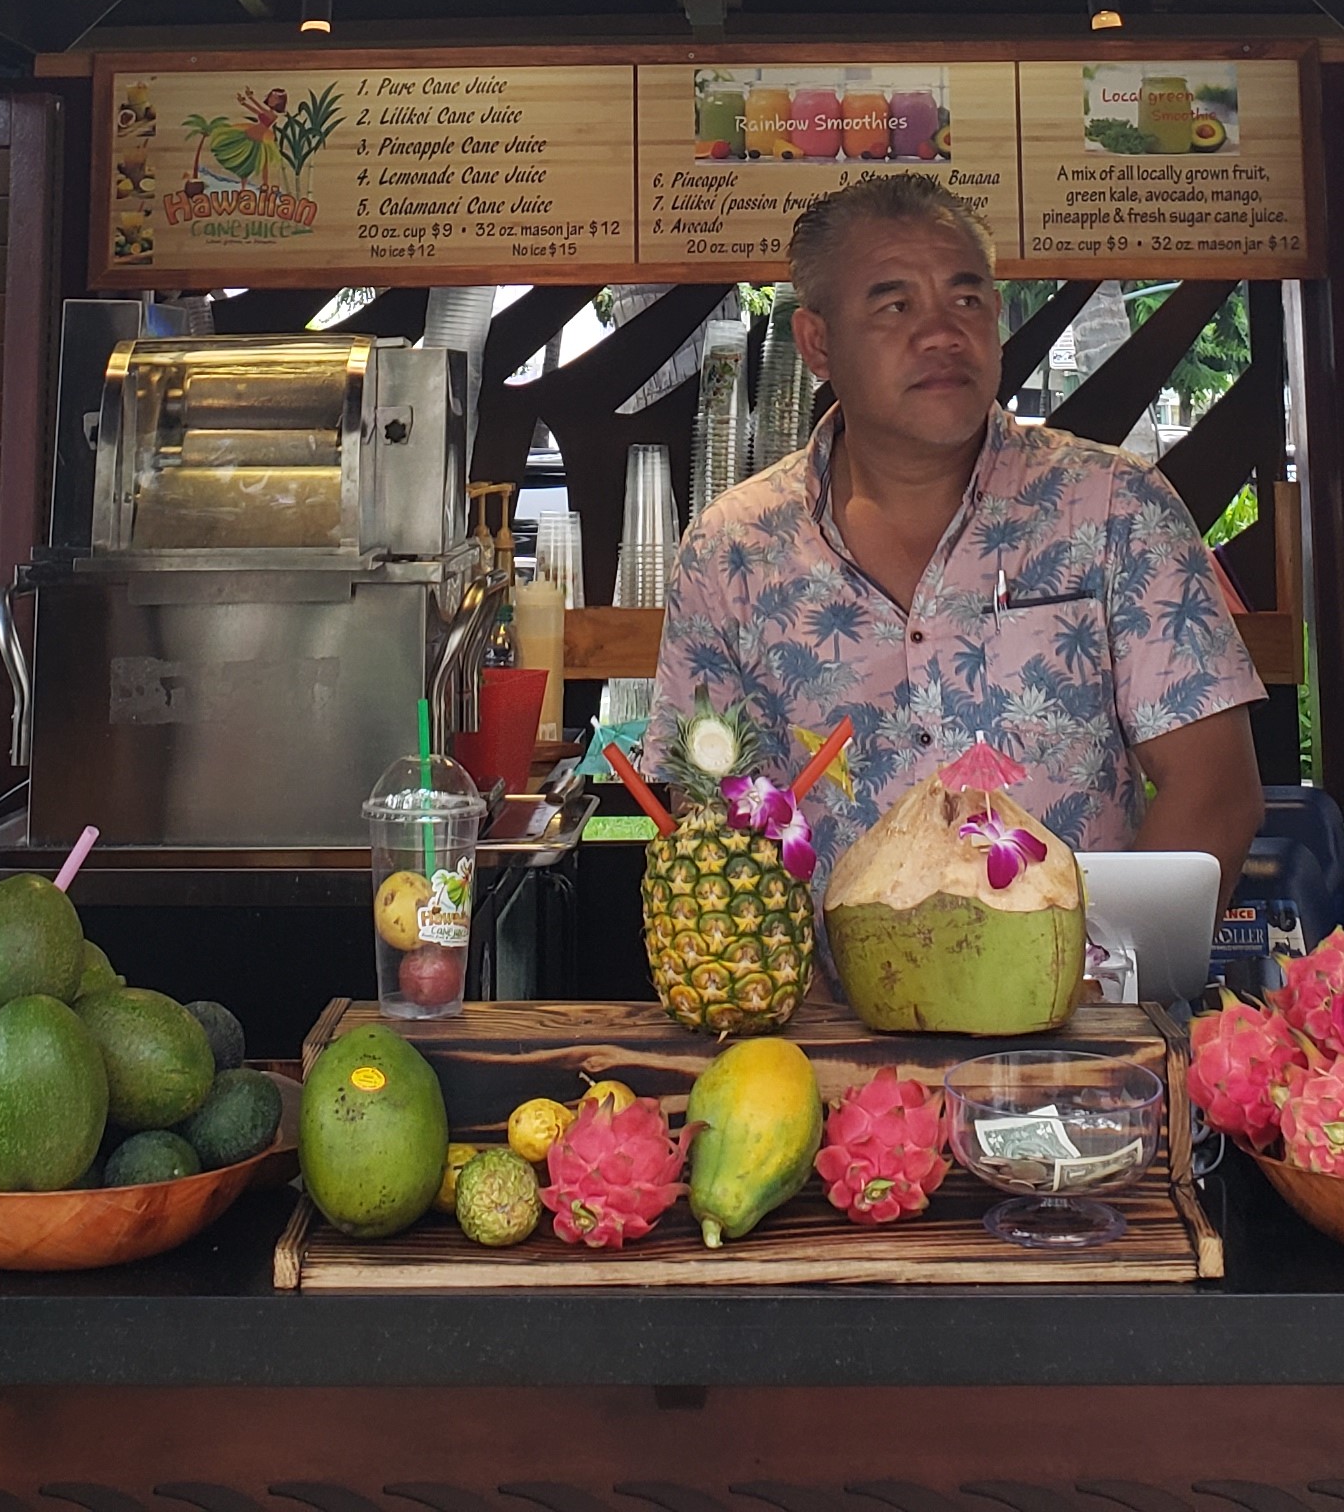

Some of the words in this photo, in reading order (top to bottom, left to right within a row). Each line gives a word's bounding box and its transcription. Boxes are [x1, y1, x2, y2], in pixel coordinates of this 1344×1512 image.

[356, 78, 369, 96] 1.
[377, 78, 415, 96] Pure
[422, 77, 460, 95] Cane
[465, 76, 508, 94] Juice
[1102, 88, 1142, 103] Local
[1149, 90, 1194, 105] green
[356, 108, 371, 126] 2.
[379, 106, 433, 125] Lilikoi
[437, 107, 475, 124] Cane
[480, 105, 523, 124] Juice
[734, 113, 809, 132] Rainbow
[814, 111, 908, 131] Smoothies
[1151, 107, 1217, 121] Smoothie
[356, 138, 370, 156] 3.
[378, 136, 455, 160] Pineapple
[461, 136, 500, 154] Cane
[505, 135, 547, 154] Juice
[357, 168, 370, 186] 4.
[378, 164, 455, 186] Lemonade
[461, 166, 500, 185] Cane
[505, 165, 547, 184] Juice
[653, 172, 664, 188] 6.
[671, 171, 738, 192] Pineapple
[948, 169, 1000, 185] Banana
[1057, 165, 1069, 181] A
[1072, 166, 1096, 181] mix
[1099, 165, 1115, 181] of
[1117, 165, 1134, 181] all
[1137, 165, 1182, 184] locally
[1185, 168, 1229, 184] grown
[1232, 164, 1270, 182] fruit,
[163, 183, 318, 226] Hawaiian
[357, 198, 370, 217] 5.
[379, 196, 463, 216] Calamanci
[467, 196, 505, 215] Cane
[510, 195, 553, 214] Juice
[652, 195, 664, 211] 7.
[671, 194, 718, 211] Lilikoi
[721, 192, 778, 215] (passion
[1066, 190, 1106, 206] green
[1109, 186, 1141, 203] kale,
[1145, 186, 1208, 203] avocado,
[1211, 190, 1262, 205] mango,
[653, 219, 664, 234] 8.
[670, 216, 723, 234] Avocado
[1042, 208, 1110, 230] pineapple
[1113, 207, 1124, 223] &
[1127, 207, 1166, 223] fresh
[1169, 211, 1211, 227] sugar
[1214, 211, 1248, 223] cane
[1249, 208, 1288, 227] juice.
[358, 224, 379, 239] 20
[381, 228, 400, 239] oz.
[403, 227, 426, 243] cup
[432, 222, 453, 238] $9
[475, 222, 496, 237] 32
[499, 226, 517, 237] oz.
[521, 224, 563, 236] mason
[564, 221, 584, 240] jar
[371, 245, 386, 258] No
[389, 245, 405, 257] ice
[512, 243, 527, 256] No
[530, 244, 546, 256] ice
[687, 239, 707, 253] 20
[731, 243, 754, 257] cup
[760, 238, 781, 255] $9
[1032, 237, 1053, 251] 20
[1078, 240, 1101, 256] cup
[1106, 235, 1128, 252] $9
[1151, 236, 1172, 251] 32
[1198, 240, 1241, 251] mason
[1243, 237, 1263, 255] jar
